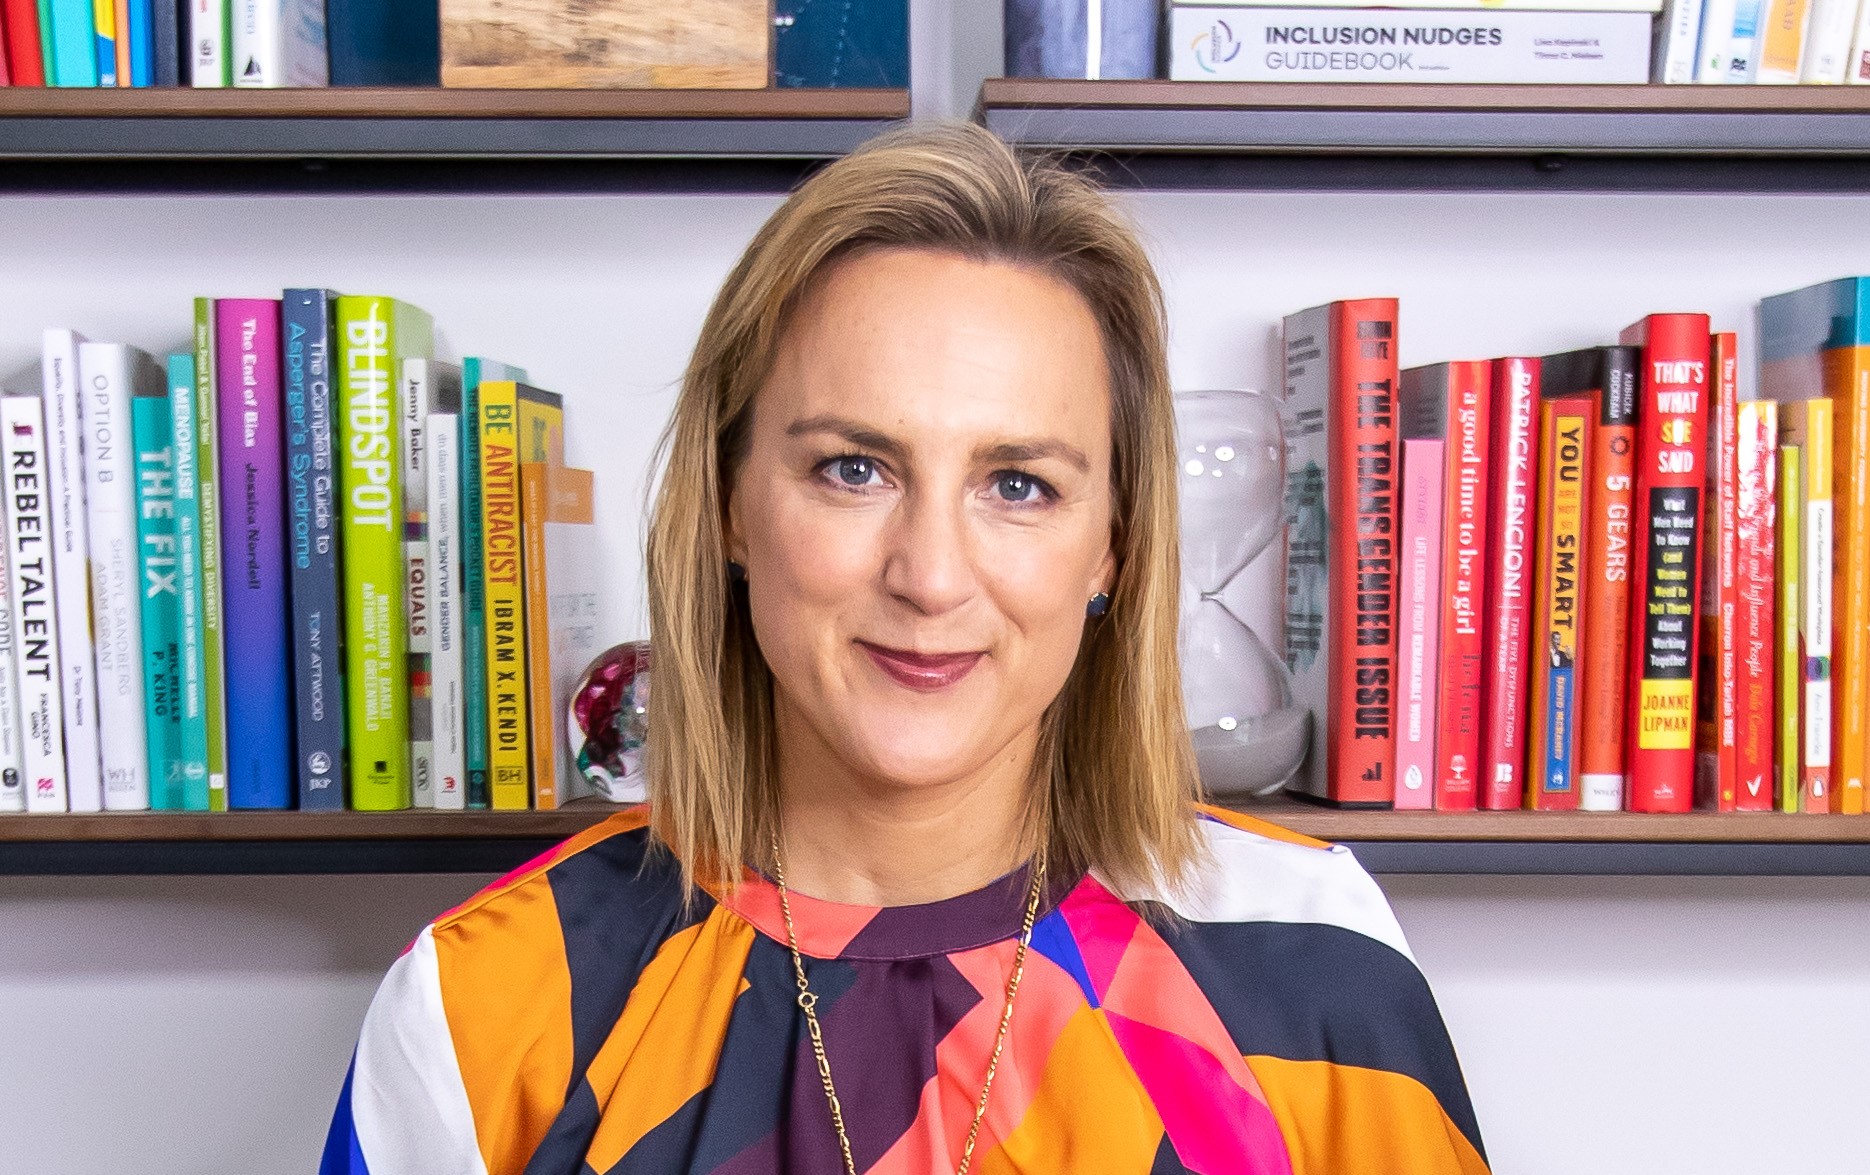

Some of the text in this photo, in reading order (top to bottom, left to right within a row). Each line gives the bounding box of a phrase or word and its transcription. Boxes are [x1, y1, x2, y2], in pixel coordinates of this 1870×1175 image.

[1264, 53, 1414, 71] GUIDEBOOK
[1265, 27, 1503, 46] INCLUSION NUDGES
[243, 318, 260, 448] The End of Bias
[1462, 392, 1478, 405] a
[1653, 361, 1704, 384] THAT'S
[93, 374, 114, 484] OPTION B
[347, 320, 393, 532] BLINDSPOT
[407, 379, 424, 471] Jenny Baker
[1357, 378, 1392, 429] THE
[1657, 391, 1699, 414] WHAT
[174, 387, 195, 500] MENOPAUSE
[288, 322, 313, 569] Asperger's Syndrome
[311, 339, 333, 555] The Complete Guide to
[1457, 408, 1482, 463] good
[1661, 419, 1693, 446] SE
[484, 404, 518, 587] BE ANTIRACIST
[1460, 468, 1480, 519] time
[1503, 371, 1533, 598] PATRICK LENCIONI
[1605, 474, 1632, 492] 5
[1722, 358, 1735, 589] The Incredible Power of Staff Networks
[140, 446, 178, 600] THE FIX
[246, 463, 262, 590] Jessica Nordell
[1357, 440, 1392, 647] TRANSGENDER
[1414, 537, 1428, 556] LIFE
[1459, 522, 1476, 546] to
[1553, 427, 1581, 630] YOU SMART
[1604, 503, 1630, 583] GEARS
[13, 450, 52, 682] REBEL TALENT
[1413, 558, 1427, 603] LESSONS
[1457, 549, 1479, 577] be
[1457, 579, 1472, 593] a
[1750, 559, 1764, 583] and
[96, 564, 114, 672] ADAM GRANT
[205, 572, 219, 629] DIVERSITY
[410, 557, 427, 636] EQUALS
[1412, 605, 1425, 632] FROM
[1452, 595, 1476, 635] girl
[1741, 585, 1765, 638] Influence
[114, 606, 132, 697] SANDBERG
[440, 601, 451, 652] GENDER
[168, 643, 182, 725] MICHELLE
[309, 612, 324, 722] TONY ATTWOOD
[494, 599, 519, 752] IBRAM X. KENDI
[1503, 617, 1520, 749] THE FIVE DYSFUNCTIONS
[1745, 641, 1764, 679] People
[154, 673, 169, 717] KING
[1355, 657, 1390, 740] ISSUE
[1555, 675, 1567, 709] DAVID
[1643, 695, 1690, 710] JOANNE
[30, 711, 42, 739] GINO
[39, 692, 53, 757] FRANCESCA
[1409, 703, 1422, 743] WOMEN
[1643, 716, 1689, 732] LIPMAN
